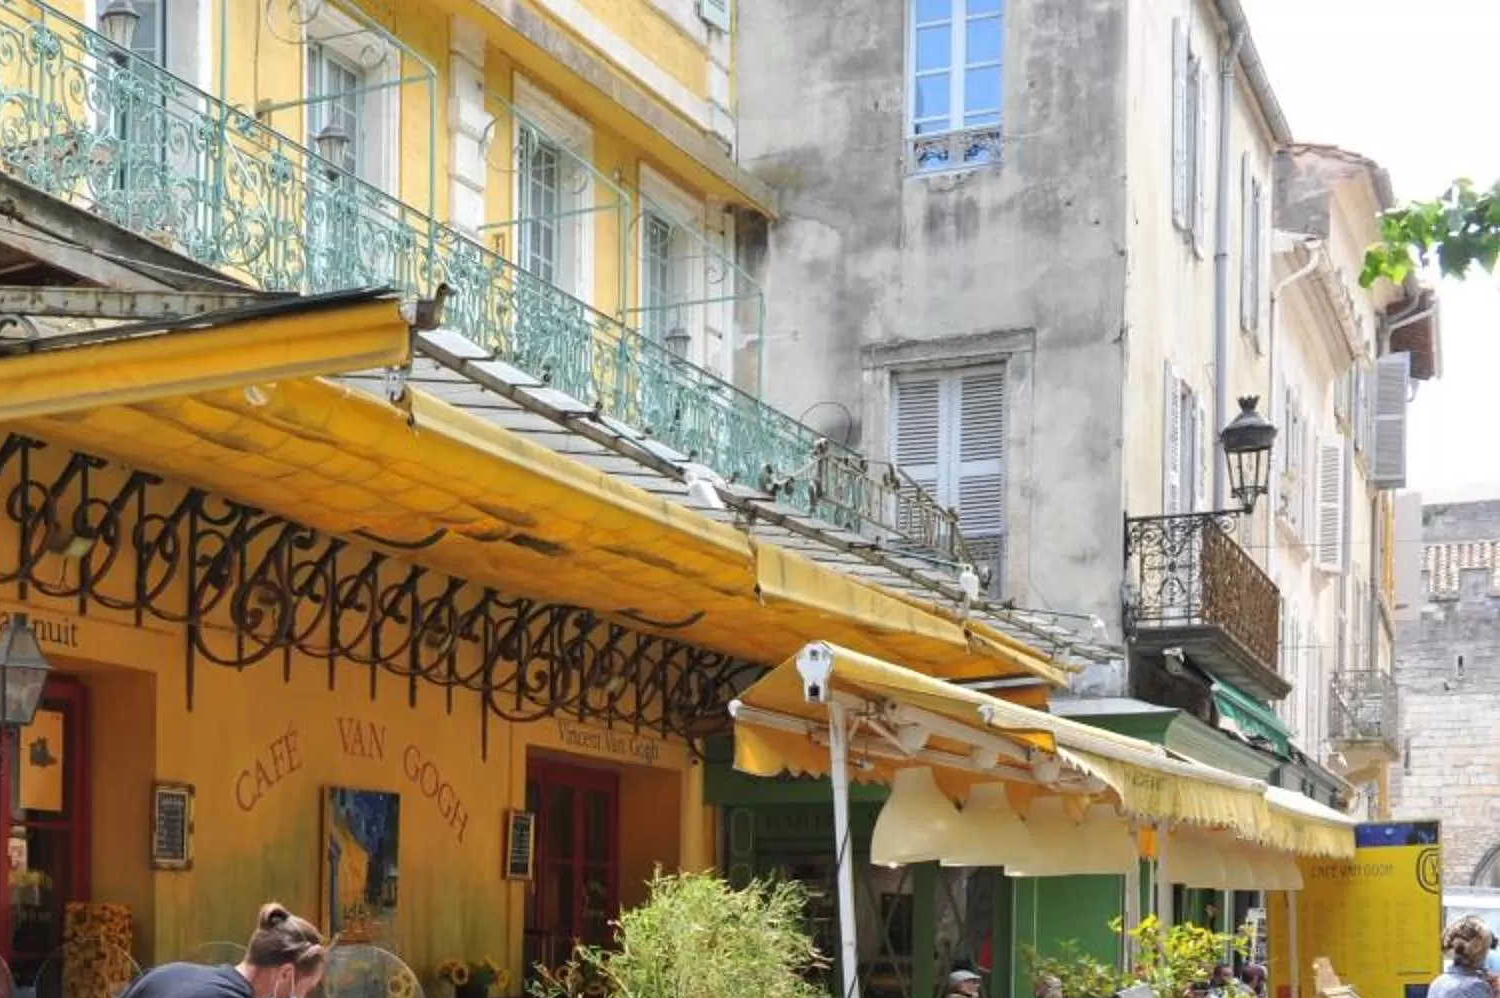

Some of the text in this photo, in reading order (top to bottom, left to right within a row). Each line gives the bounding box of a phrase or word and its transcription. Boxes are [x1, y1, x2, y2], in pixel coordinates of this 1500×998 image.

[235, 720, 303, 813] CAFÉ
[335, 716, 388, 761] VAN
[402, 744, 470, 844] GOGH
